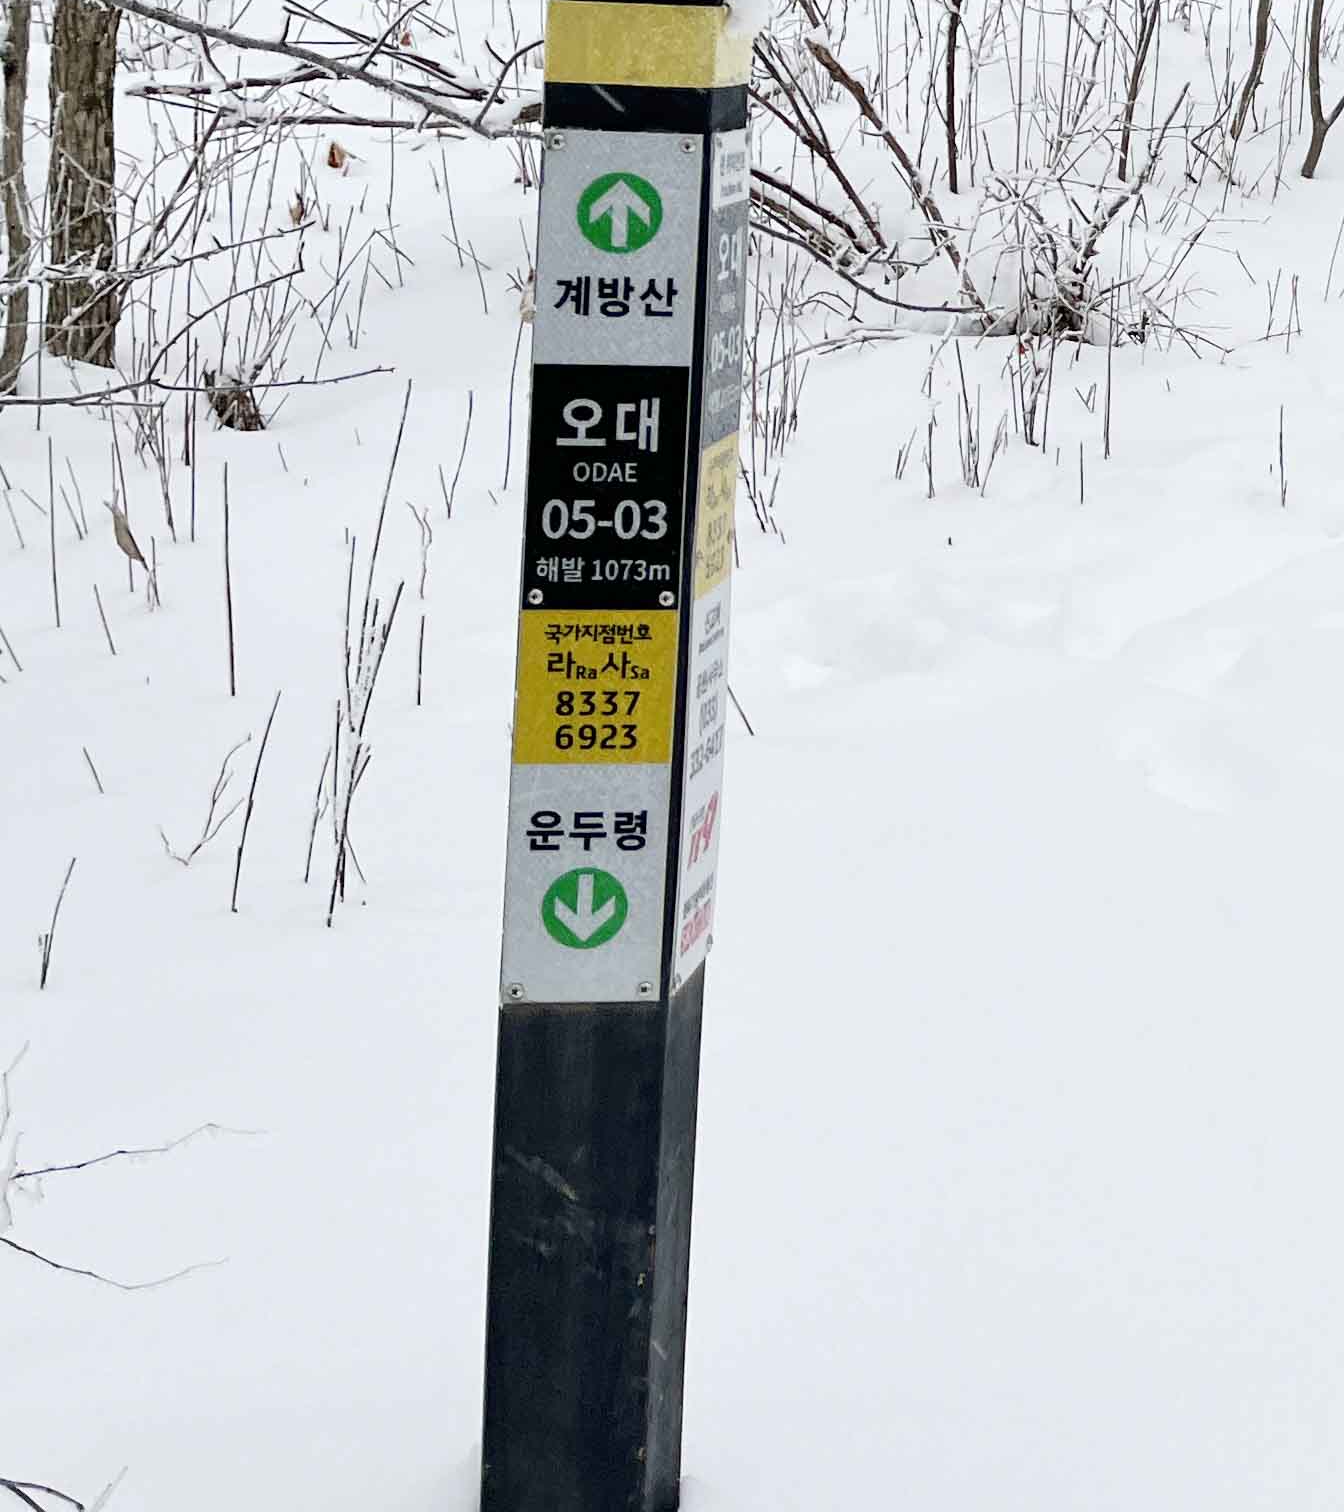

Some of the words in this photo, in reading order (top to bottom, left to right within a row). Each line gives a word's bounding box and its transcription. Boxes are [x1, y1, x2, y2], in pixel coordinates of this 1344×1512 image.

[554, 276, 678, 318] 계방산
[556, 397, 660, 452] 오대
[573, 463, 639, 483] ODAE
[541, 498, 668, 540] 05-03
[536, 557, 585, 583] 해발
[591, 558, 670, 582] 1073m
[544, 623, 653, 645] 국가지점번호
[555, 691, 641, 717] 8337
[554, 724, 638, 750] 6923
[526, 809, 650, 852] 운두령
